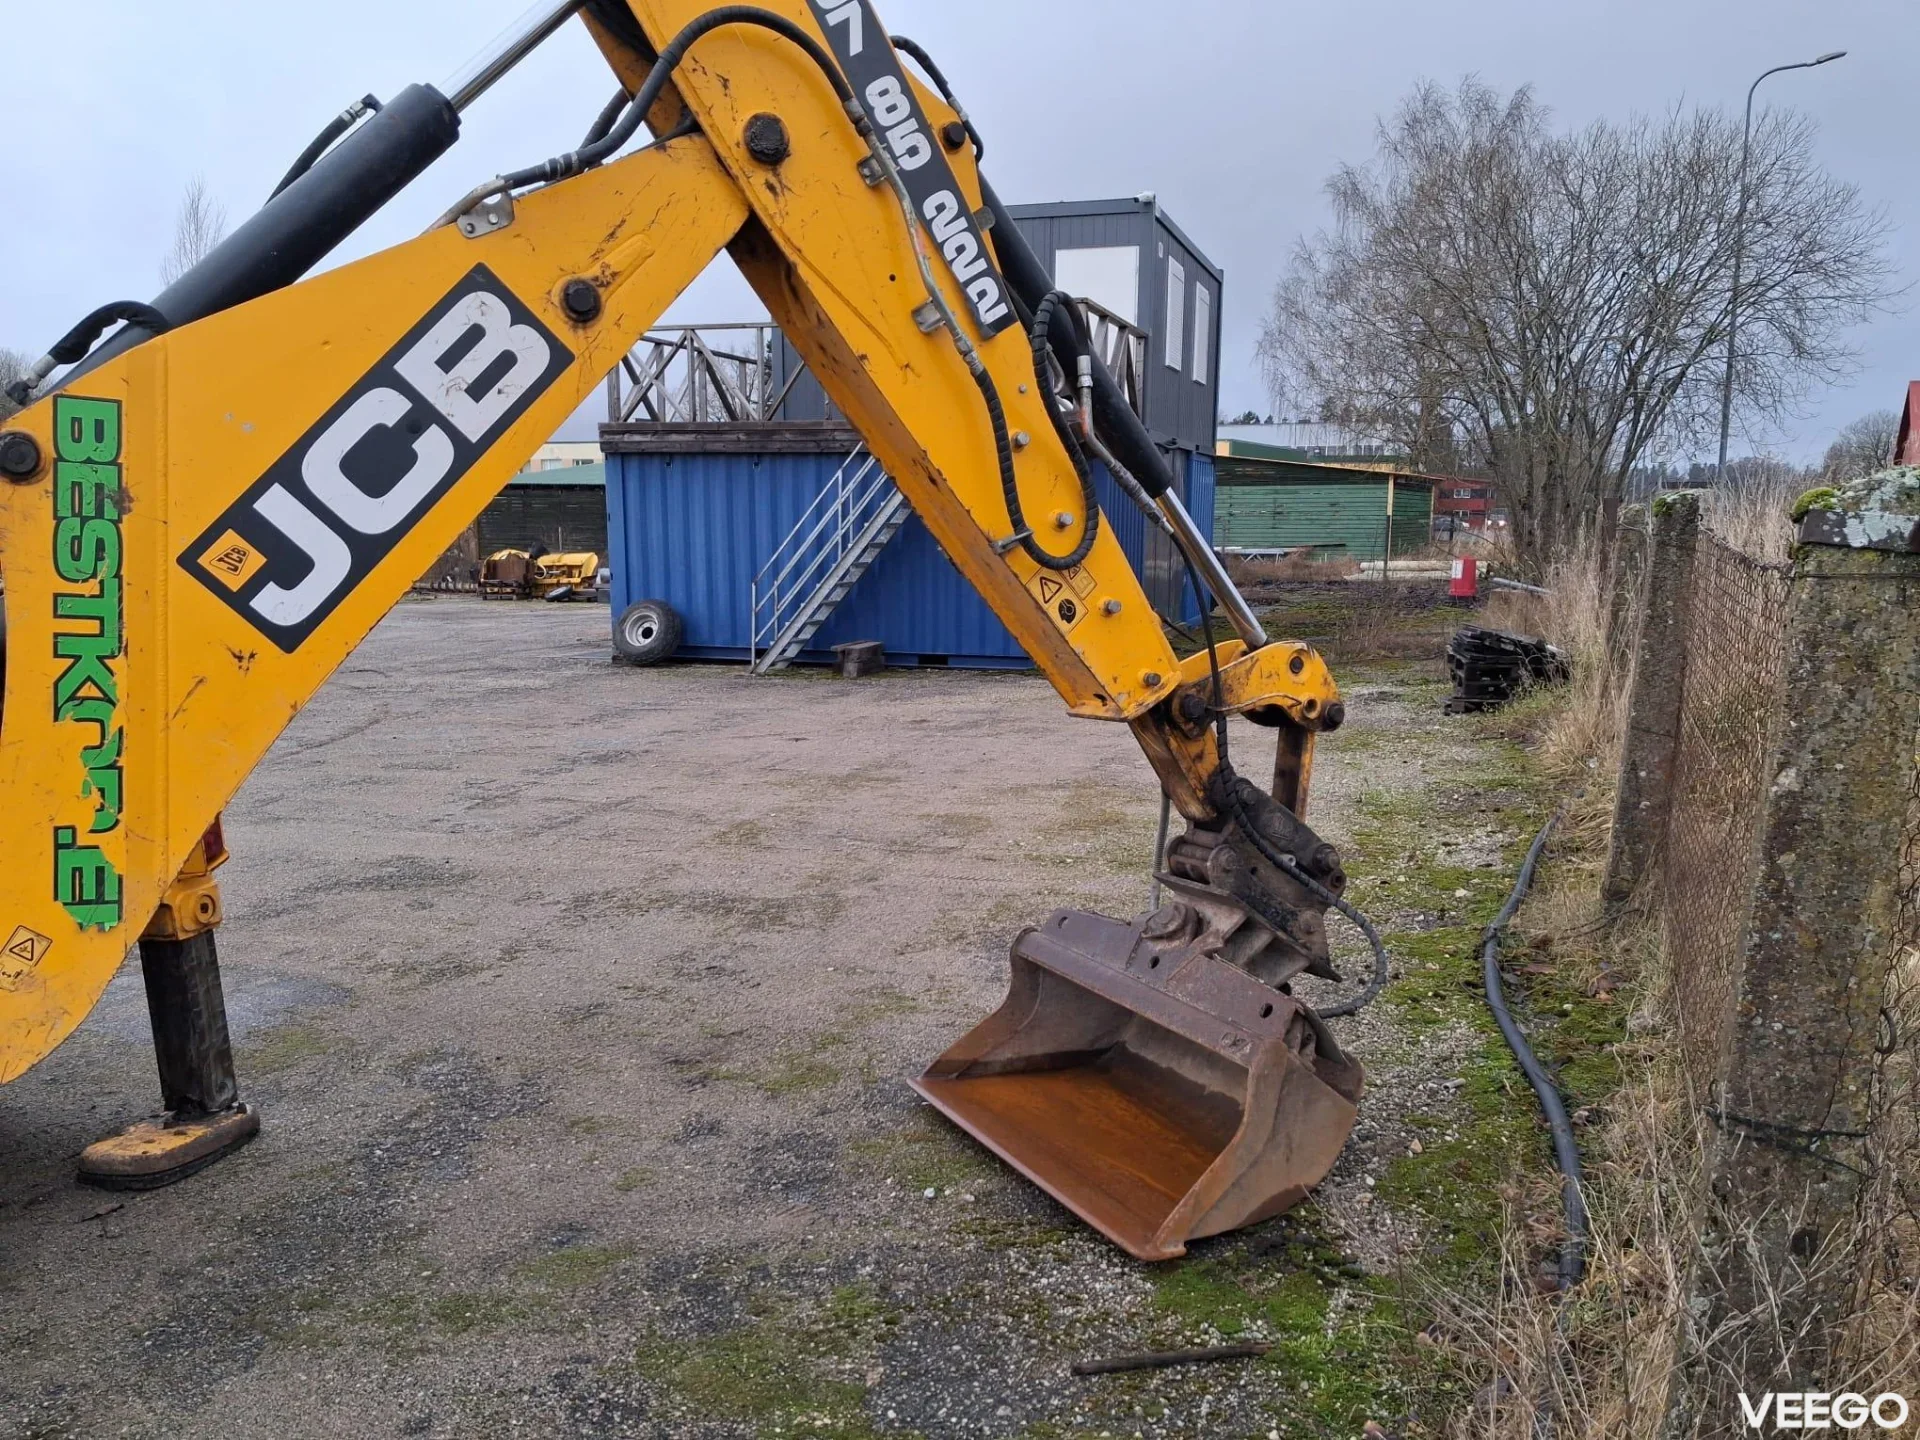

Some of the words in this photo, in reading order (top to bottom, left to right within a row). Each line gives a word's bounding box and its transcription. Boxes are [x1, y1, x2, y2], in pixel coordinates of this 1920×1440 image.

[813, 0, 863, 57] 7
[865, 75, 932, 171] 85
[922, 189, 1008, 325] 222
[215, 547, 247, 573] JCB
[249, 291, 551, 626] JCB
